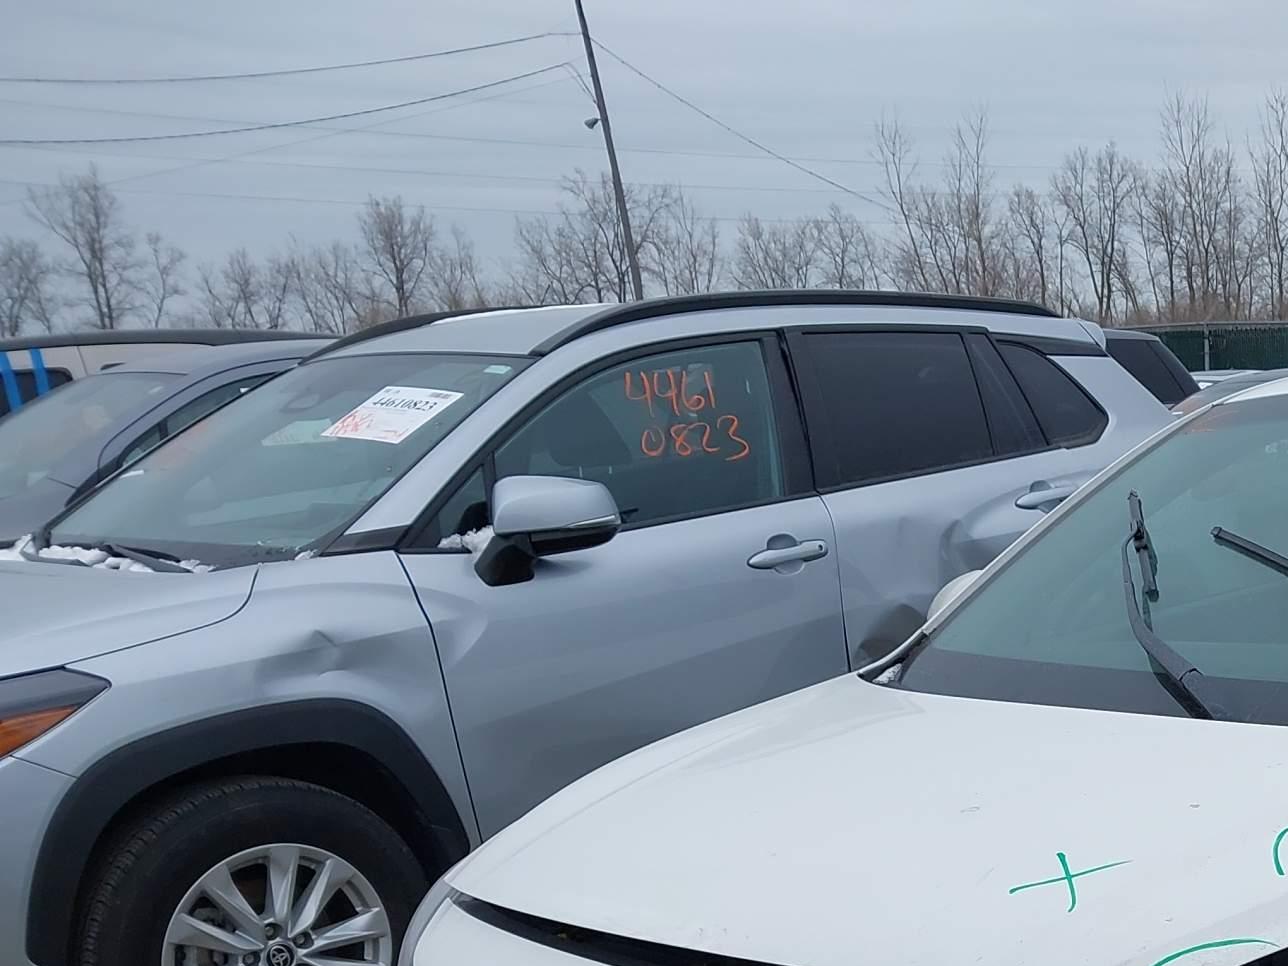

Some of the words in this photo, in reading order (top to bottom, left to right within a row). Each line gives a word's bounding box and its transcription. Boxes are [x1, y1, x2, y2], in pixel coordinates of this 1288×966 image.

[372, 397, 438, 412] 44610823
[623, 371, 716, 418] 4461
[641, 415, 750, 461] 0823
